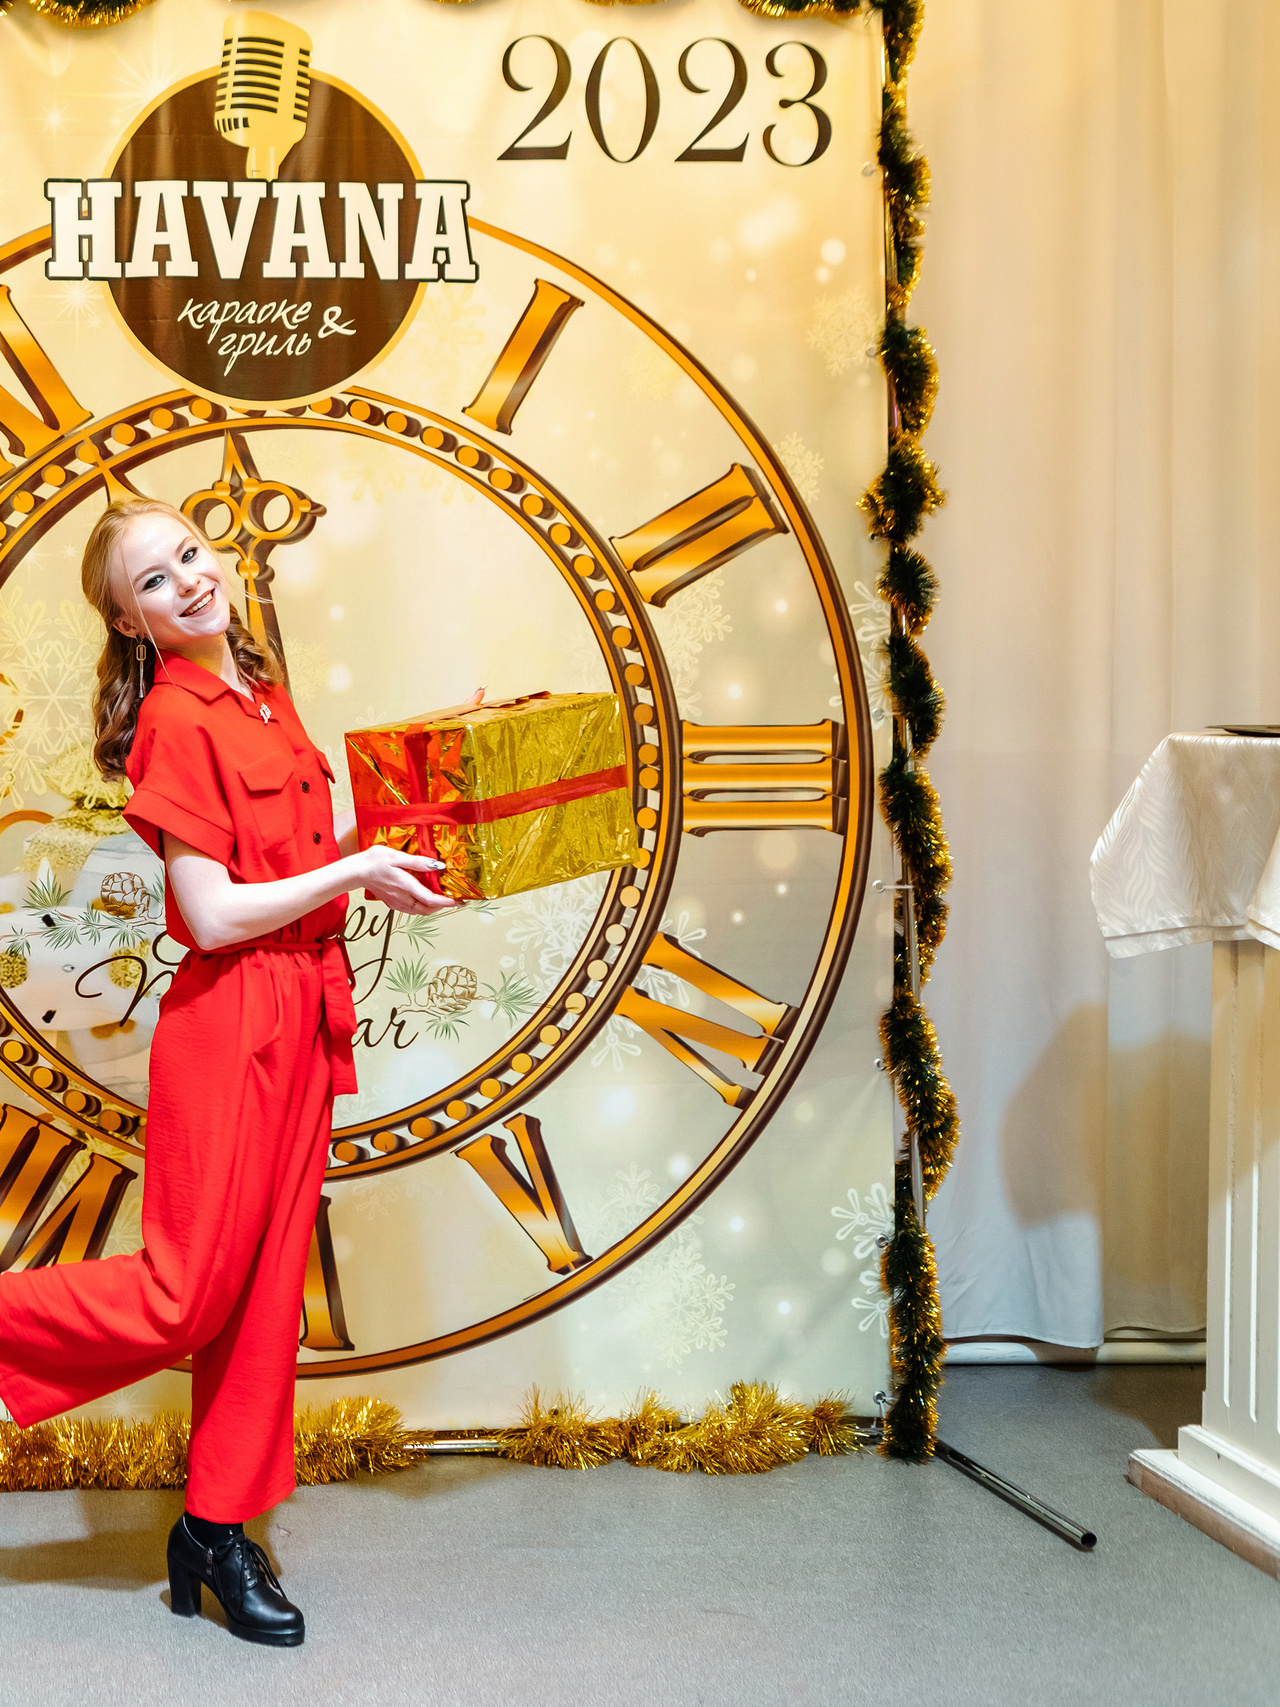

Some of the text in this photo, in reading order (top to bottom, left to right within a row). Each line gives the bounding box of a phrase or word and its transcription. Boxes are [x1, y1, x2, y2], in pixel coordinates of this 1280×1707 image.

[496, 34, 833, 168] 2023
[44, 178, 480, 283] HAVANA
[177, 297, 357, 345] караоке &
[217, 330, 312, 377] гриль
